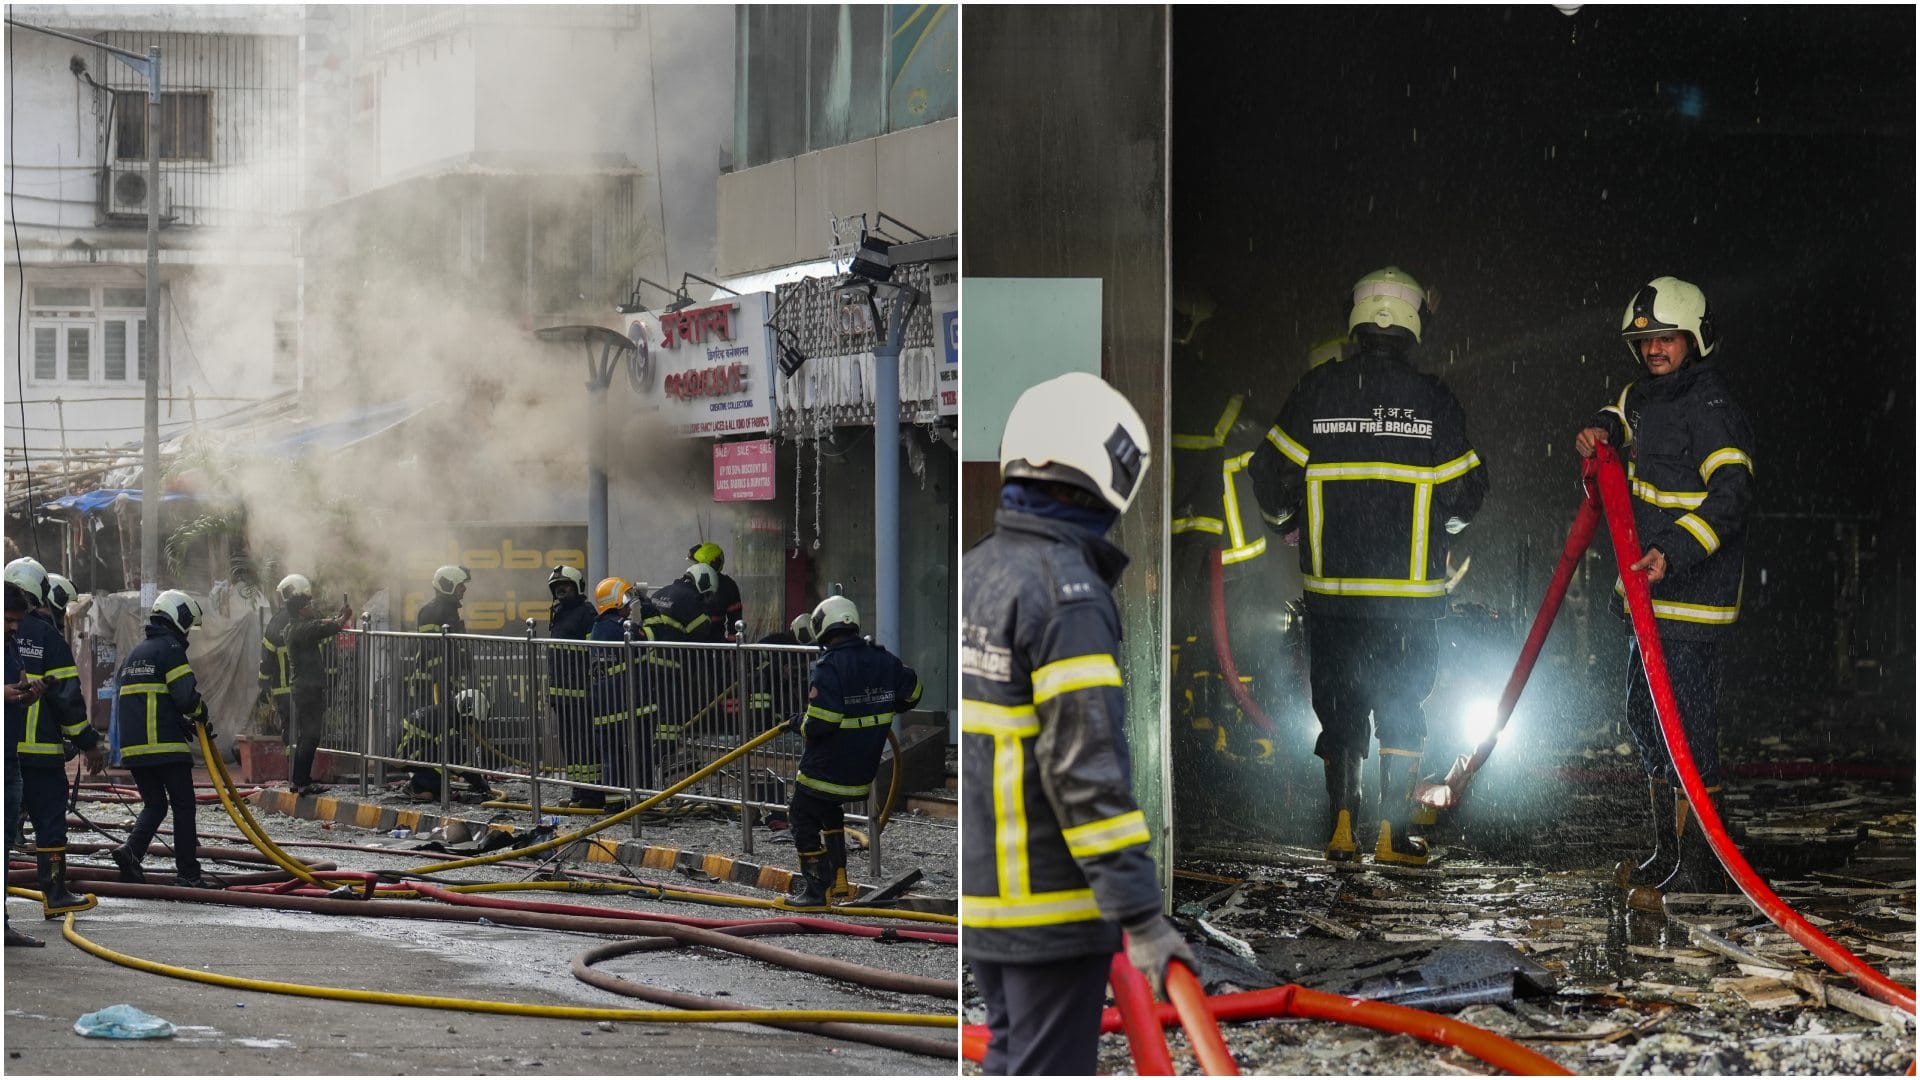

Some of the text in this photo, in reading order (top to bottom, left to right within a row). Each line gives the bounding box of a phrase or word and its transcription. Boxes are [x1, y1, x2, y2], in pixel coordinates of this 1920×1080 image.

[728, 400, 753, 410] COLLECTIONS
[1313, 421, 1433, 436] MUMBAI FIRE BRIGADE
[715, 443, 771, 458] SALE SALE SALE
[741, 463, 761, 474] DISCOUNT
